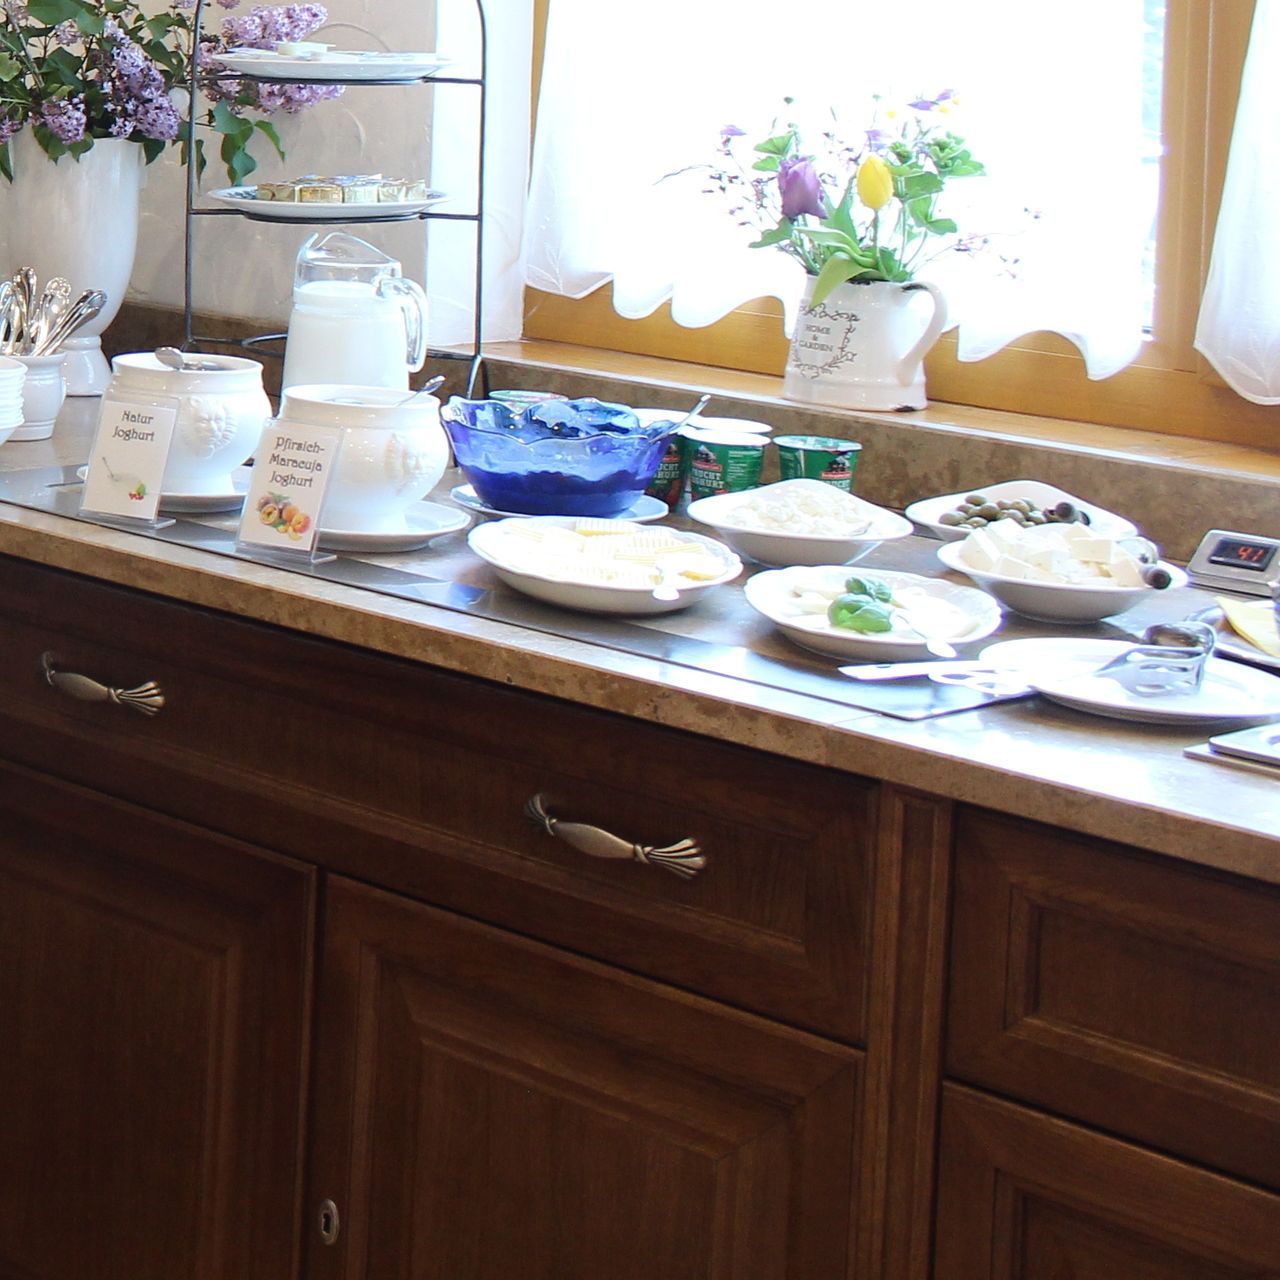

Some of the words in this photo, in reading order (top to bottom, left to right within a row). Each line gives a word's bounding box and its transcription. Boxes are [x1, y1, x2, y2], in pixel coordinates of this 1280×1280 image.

[806, 324, 831, 334] HOME
[799, 340, 834, 352] GARDEN
[121, 410, 154, 424] Natur
[112, 426, 155, 441] Joghurt
[274, 436, 325, 453] Pfirsich-
[269, 453, 322, 473] Maracuja
[269, 470, 313, 487] Joghurt
